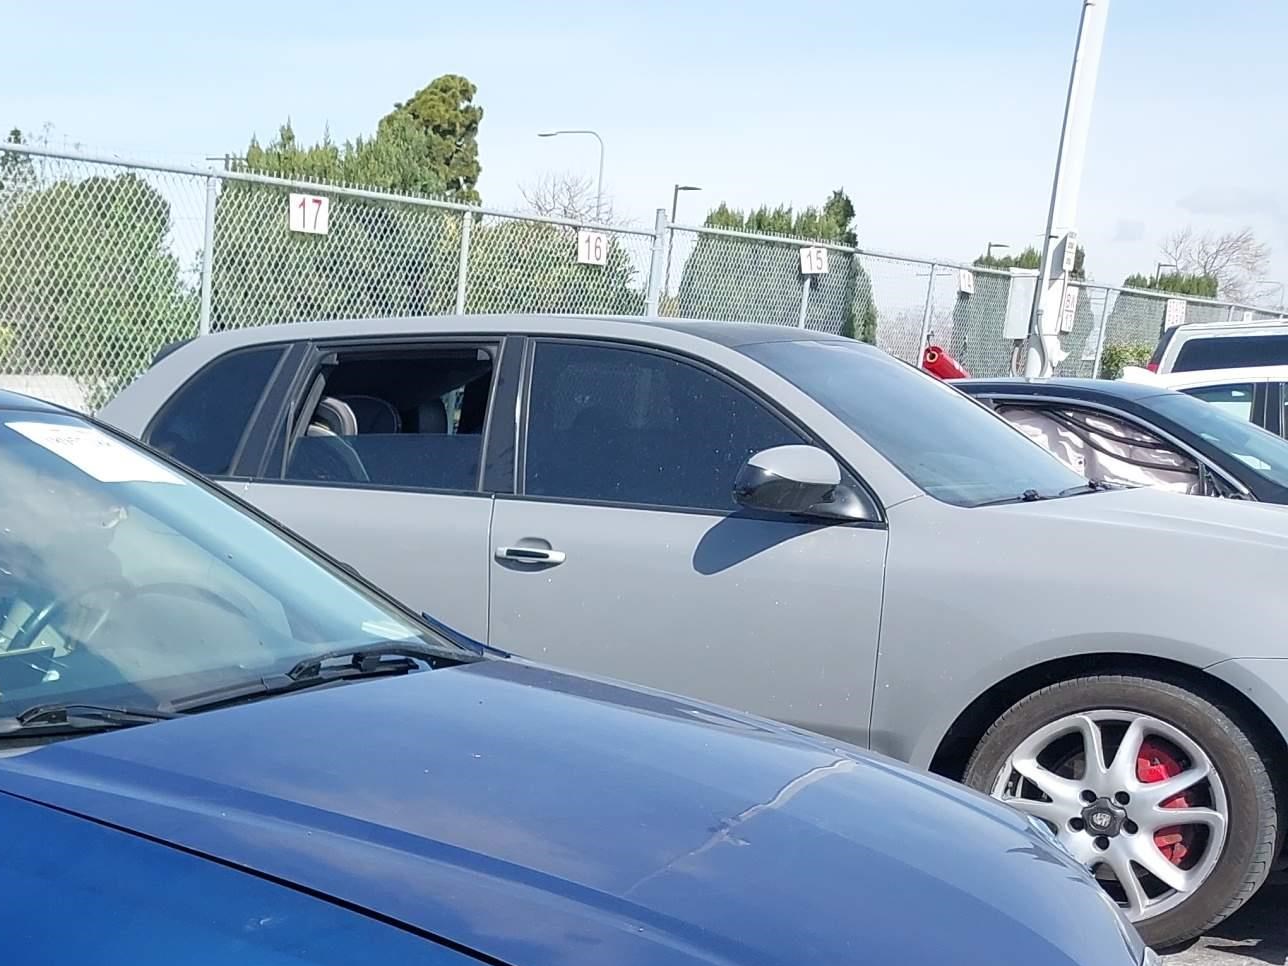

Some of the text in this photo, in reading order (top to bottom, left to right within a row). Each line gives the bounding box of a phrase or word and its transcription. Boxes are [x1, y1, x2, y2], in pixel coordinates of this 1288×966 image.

[298, 197, 322, 231] 17
[585, 234, 602, 261] 16
[806, 249, 823, 272] 15
